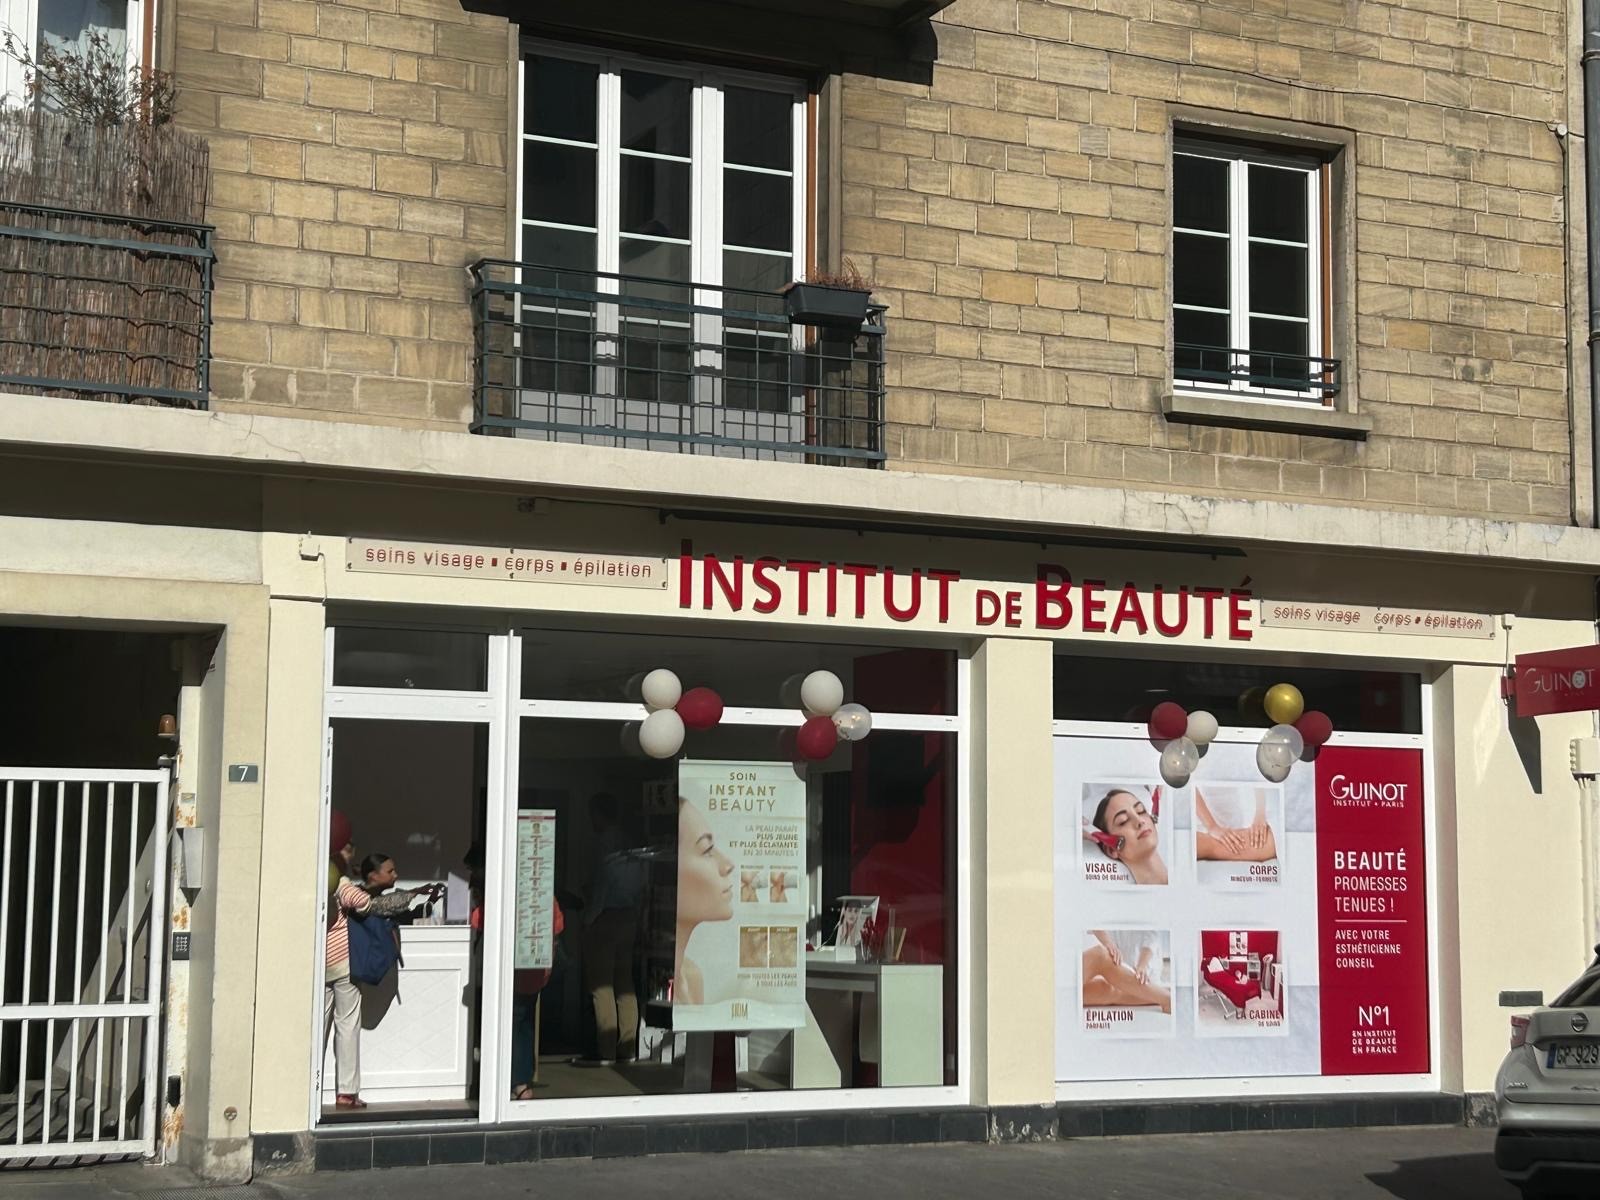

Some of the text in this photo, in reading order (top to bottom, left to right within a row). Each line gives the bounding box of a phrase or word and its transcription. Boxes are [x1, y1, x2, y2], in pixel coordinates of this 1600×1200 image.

[366, 547, 652, 578] soins visage corps épilation
[679, 538, 1253, 641] INSTITUT DE BEAUTÉ
[1274, 605, 1483, 630] soins visage corps épilation
[1523, 668, 1595, 692] GUINOT
[238, 766, 248, 782] 7
[730, 772, 756, 781] SOIN
[709, 784, 776, 796] INSTANT
[1329, 774, 1408, 800] GUINOT
[708, 798, 776, 812] BEAUTY
[1334, 800, 1404, 808] INSTITUT PARIS
[756, 832, 798, 840] PLUS JEUNE
[730, 840, 798, 848] ET PLUS ÉCLATANTE
[1334, 848, 1406, 870] BEAUTÉ
[1086, 862, 1117, 873] VISAGE
[1250, 864, 1278, 875] CORPS
[1334, 876, 1407, 892] PROMESSES
[1334, 896, 1386, 912] TENUES
[1335, 929, 1390, 940] AVEC VOTRE
[1336, 942, 1400, 954] ESTHÉTICIENNE
[1336, 958, 1374, 968] CONSEIL
[1086, 1008, 1133, 1022] ÉPILATION
[1236, 1009, 1280, 1020] LA CABINE
[1352, 1046, 1397, 1054] EN FRANCE
